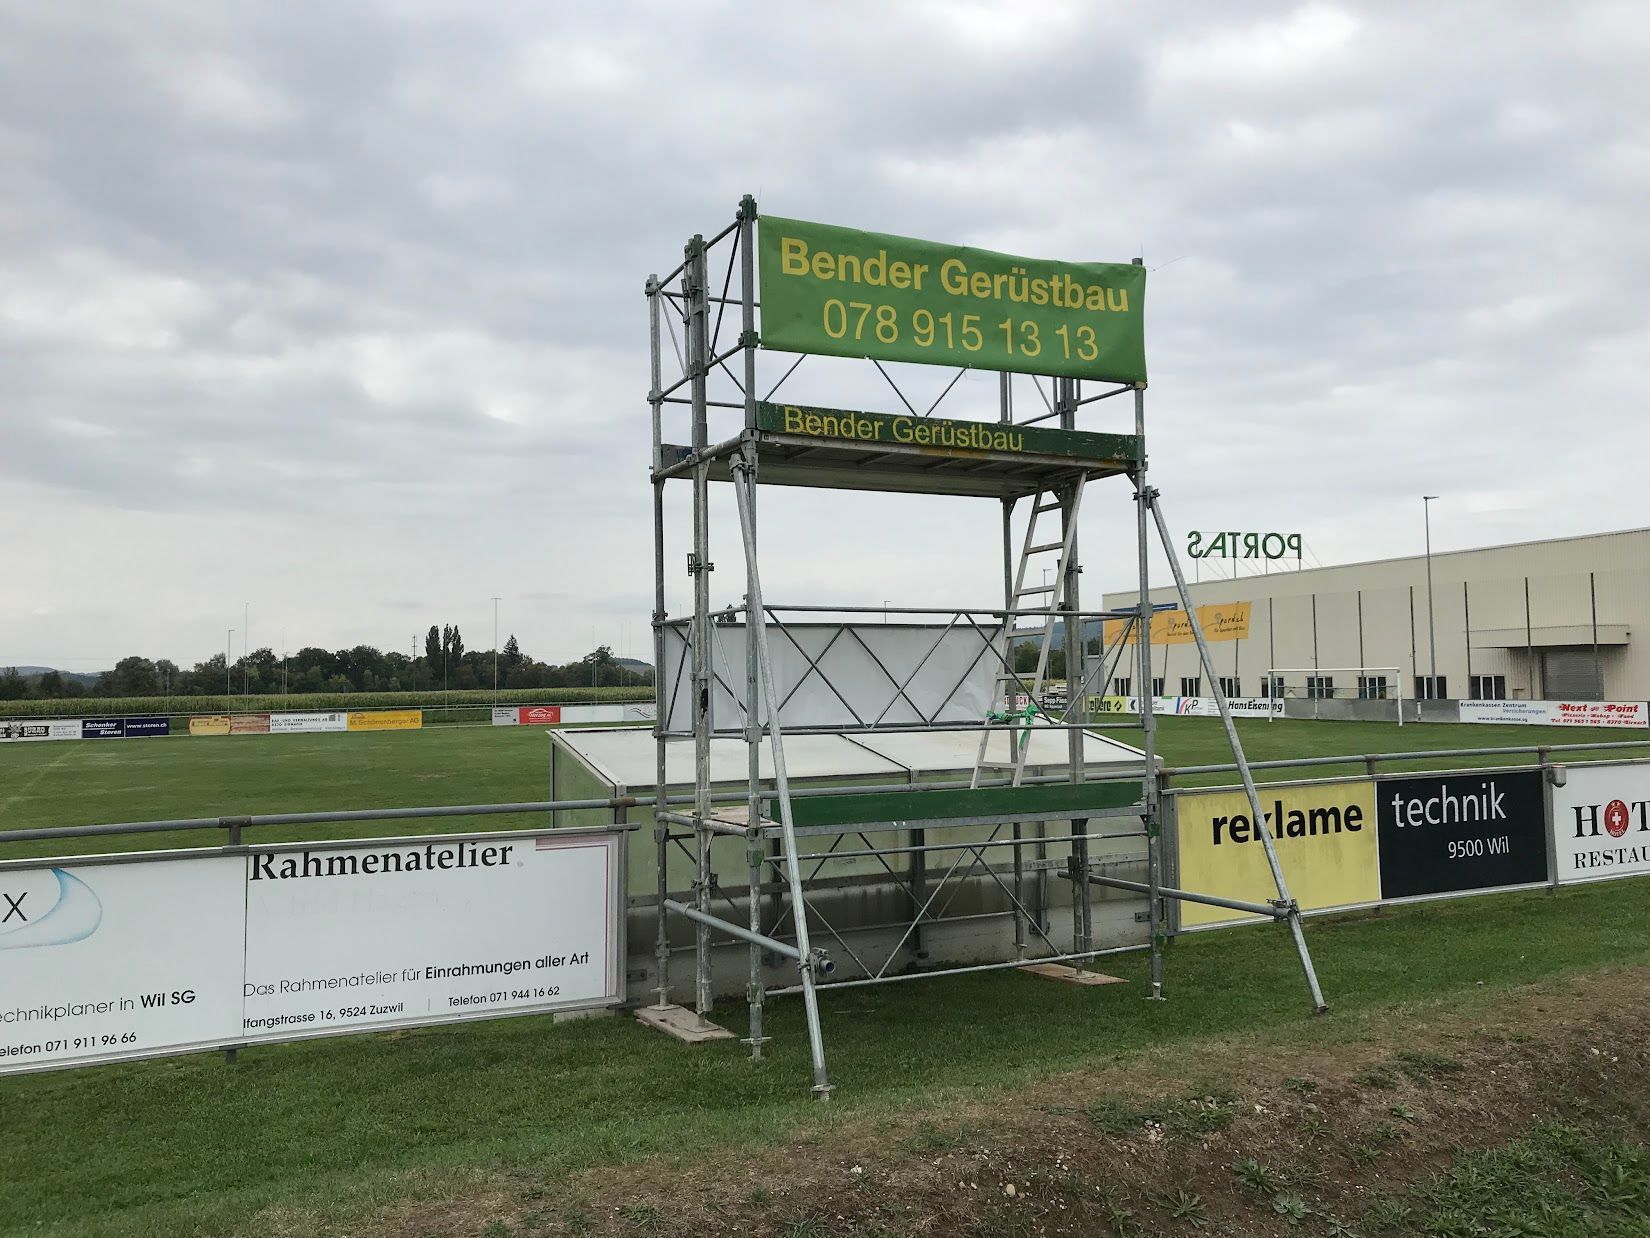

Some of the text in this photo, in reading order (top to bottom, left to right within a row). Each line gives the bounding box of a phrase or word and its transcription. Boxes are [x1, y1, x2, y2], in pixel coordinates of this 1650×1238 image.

[780, 236, 1129, 312] Bender Gerüstbau
[822, 298, 1099, 361] 078 915 13 13
[783, 405, 1023, 453] Bender Gerüstbau
[1559, 703, 1639, 712] Next Point
[1212, 800, 1363, 845] reklame
[1392, 781, 1507, 828] technik
[249, 843, 513, 881] Rahmenatelier
[1448, 835, 1509, 859] 9500 Wil
[243, 952, 589, 997] Das Rahmenatelier für Einrahmungen aller Art
[0, 990, 196, 1022] chnikplaner in Wil SG
[448, 986, 560, 1007] Telefon 071 944 16 62
[243, 1003, 404, 1029] Ifangstrasse 16, 9524 Zuzwil
[45, 1039, 68, 1052] 071
[73, 1037, 96, 1049] 911
[101, 1034, 117, 1046] 96
[121, 1032, 137, 1044] 66
